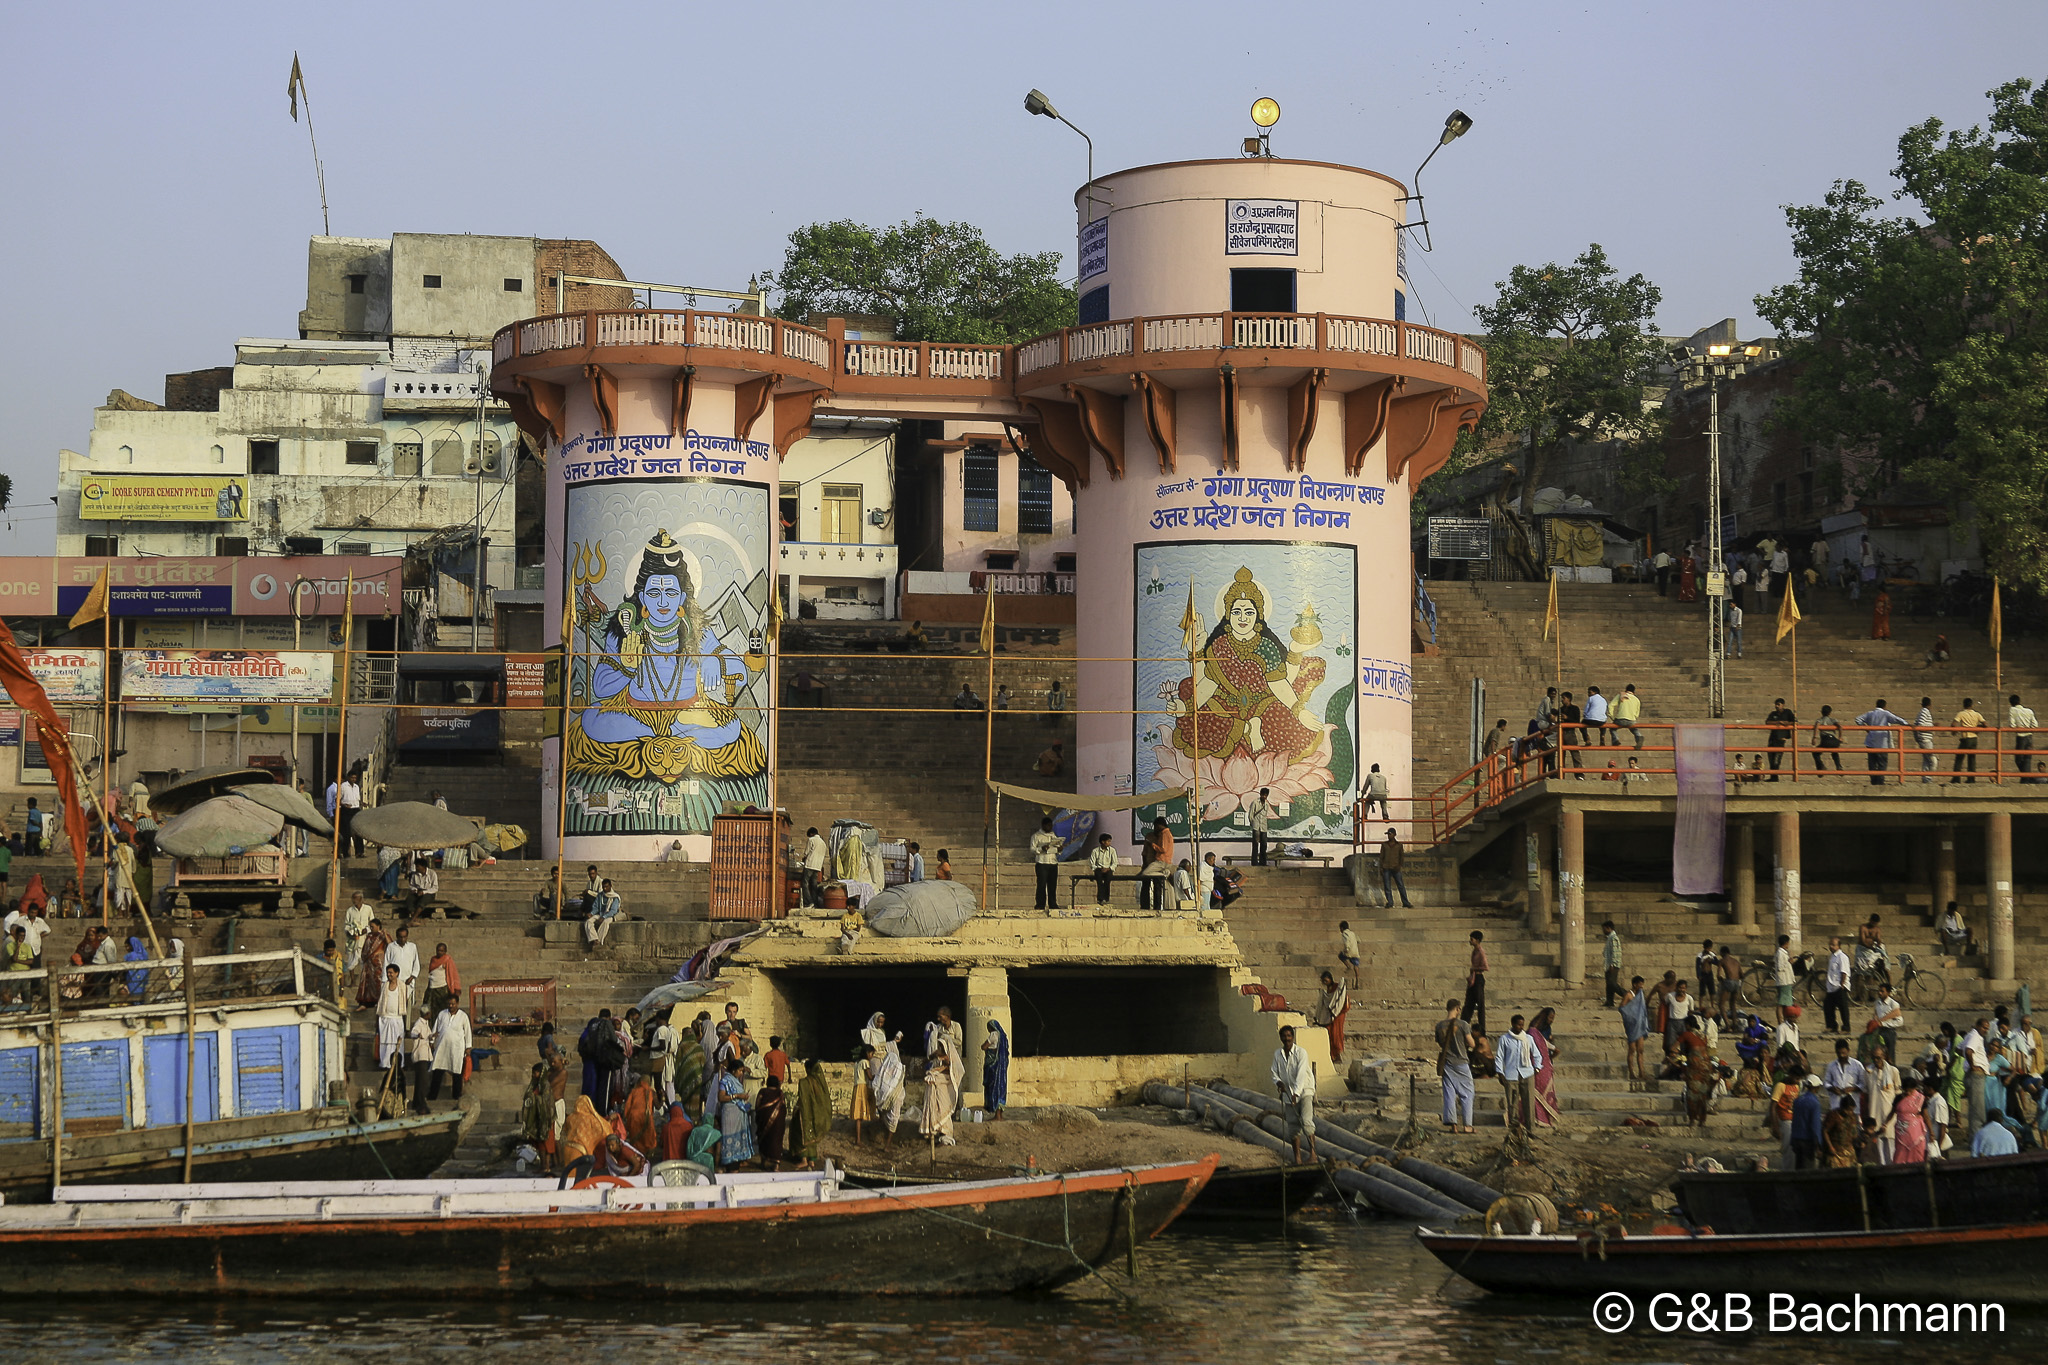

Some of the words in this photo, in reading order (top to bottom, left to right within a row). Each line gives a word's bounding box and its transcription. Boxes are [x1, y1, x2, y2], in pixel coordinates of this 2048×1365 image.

[1276, 205, 1295, 220] निगम
[1272, 235, 1295, 249] स्टेशन
[586, 430, 616, 454] गंगा
[619, 434, 672, 456] प्रदूषण
[745, 440, 770, 461] खण्ड
[563, 461, 591, 481] उत्तर
[593, 453, 637, 478] प्रदेश
[641, 458, 682, 474] जल
[688, 450, 747, 475] निगम
[112, 487, 133, 497] ICORE
[133, 487, 156, 497] SUPER
[156, 487, 185, 497] CEMENT
[200, 487, 215, 497] LTD.
[1202, 469, 1245, 497] गंगा
[1245, 477, 1296, 504] प्रदूषण
[1357, 485, 1386, 506] खण्ड
[1149, 507, 1189, 530] उत्तर
[1192, 498, 1240, 530] प्रदेश
[1241, 507, 1287, 529] जल
[1292, 502, 1351, 529] निगम
[134, 560, 218, 587] पुलिस
[145, 656, 184, 677] गंगा
[187, 657, 226, 677] सेवा
[226, 656, 287, 678] समिति
[1363, 662, 1388, 691] गंगा
[423, 717, 448, 728] पर्यटन
[448, 717, 472, 731] पुलिस
